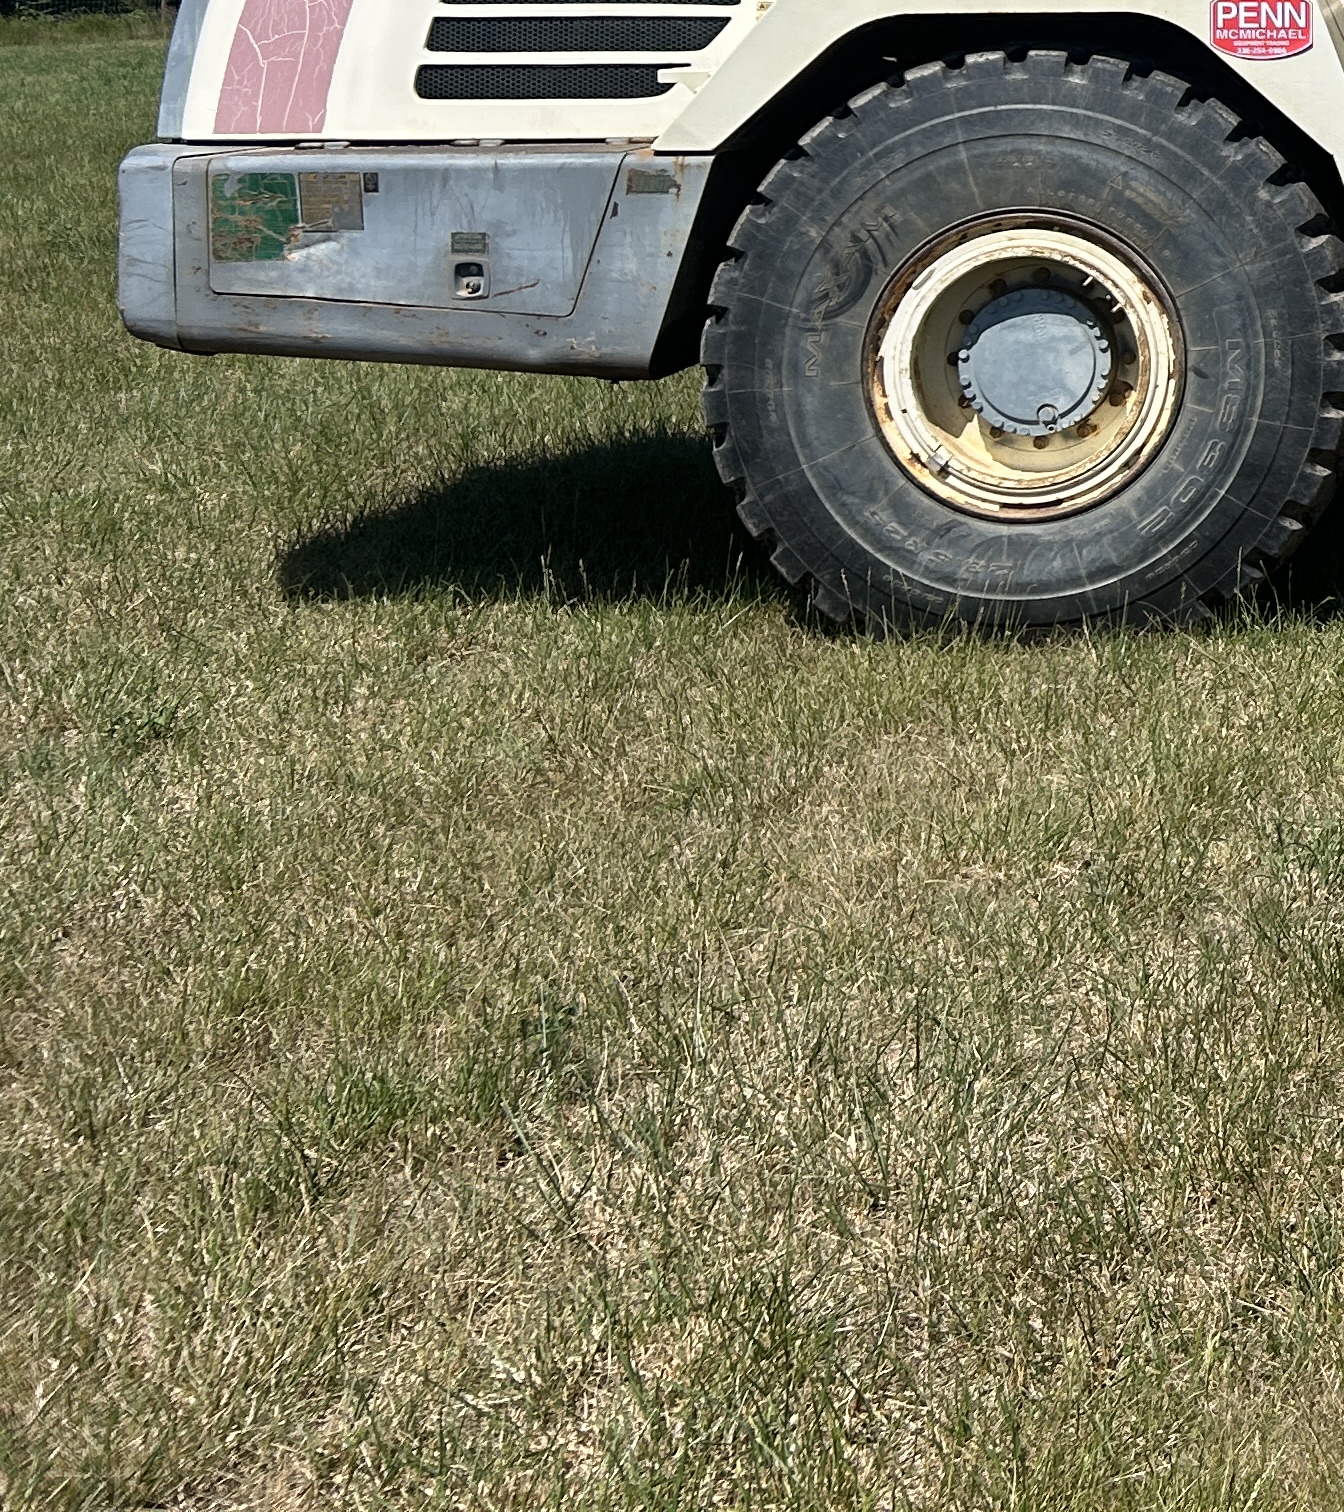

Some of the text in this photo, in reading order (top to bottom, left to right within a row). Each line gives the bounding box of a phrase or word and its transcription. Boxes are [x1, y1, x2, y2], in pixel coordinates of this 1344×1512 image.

[1217, 1, 1306, 29] PENN
[1216, 29, 1307, 40] MCMICHAEL
[1136, 338, 1245, 536] MS302
